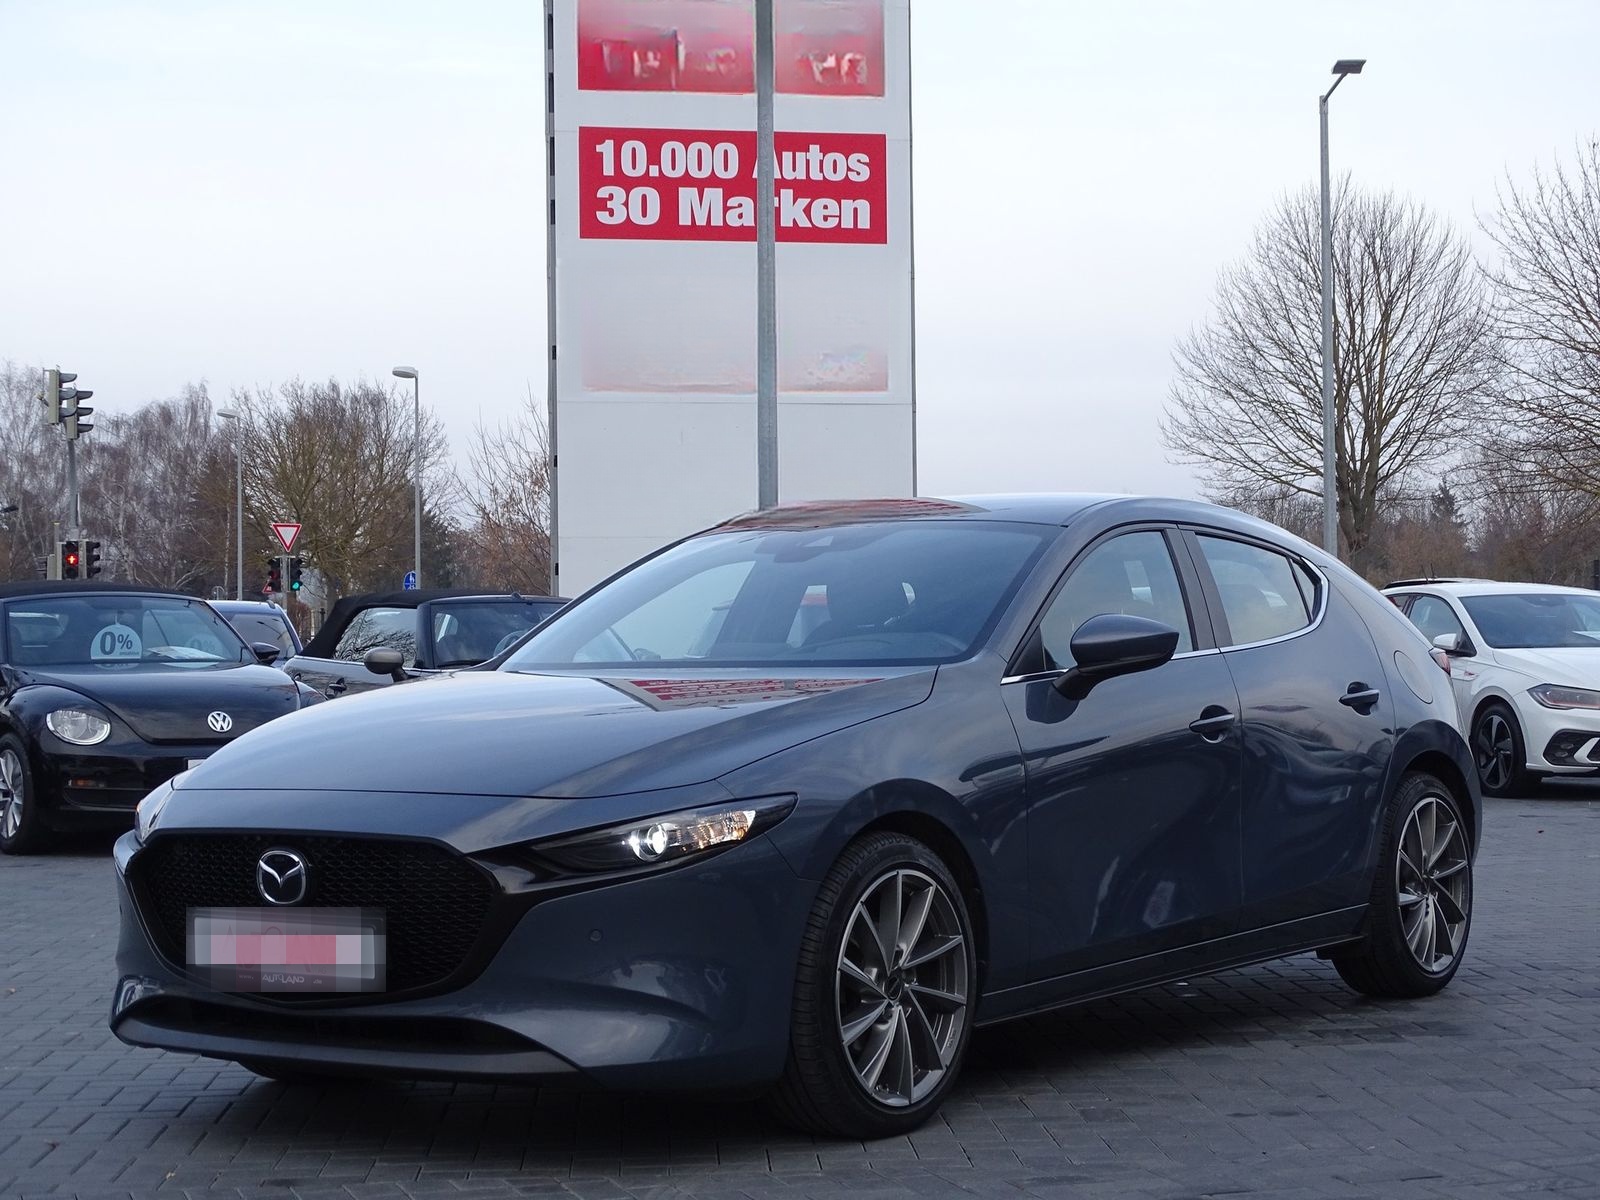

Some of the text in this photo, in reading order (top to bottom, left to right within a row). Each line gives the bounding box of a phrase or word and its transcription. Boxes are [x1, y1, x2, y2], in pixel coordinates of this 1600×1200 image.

[596, 139, 739, 179] 10.000
[596, 186, 871, 230] 30 Maken
[100, 631, 133, 656] 0%
[262, 973, 305, 984] AUTOLAND
